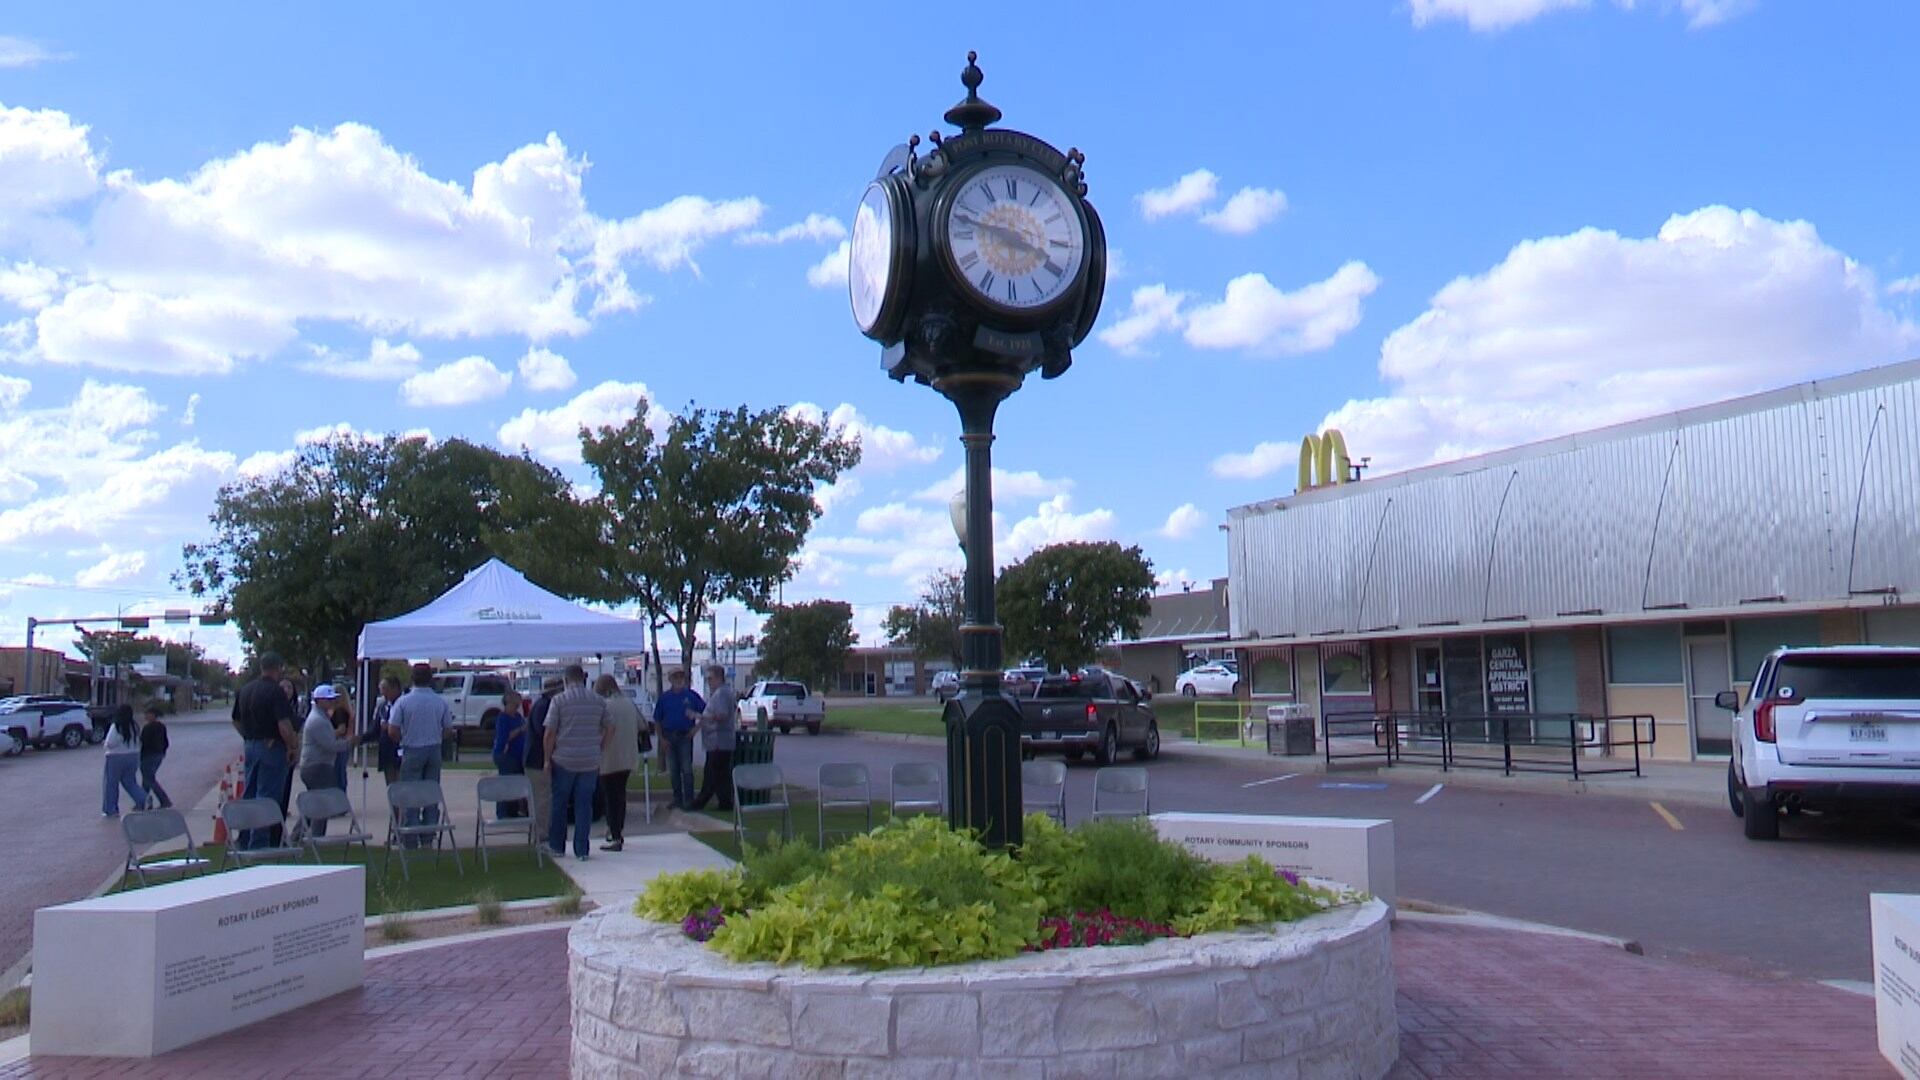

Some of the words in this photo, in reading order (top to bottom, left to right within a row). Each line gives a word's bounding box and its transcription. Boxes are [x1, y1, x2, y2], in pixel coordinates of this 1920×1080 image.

[983, 133, 1031, 150] ROTARY
[1491, 648, 1518, 658] GARZA
[1489, 659, 1524, 671] CENTRAL
[1488, 670, 1530, 682] APPRAISAL
[1490, 681, 1525, 692] DISTRICT
[1184, 835, 1216, 845] ROTARY
[1217, 837, 1264, 848] COMMUNITY
[1265, 840, 1310, 850] SPONSORS
[218, 911, 248, 928] ROTARY
[250, 903, 280, 920] LEGACY
[282, 895, 319, 912] SPONSORS
